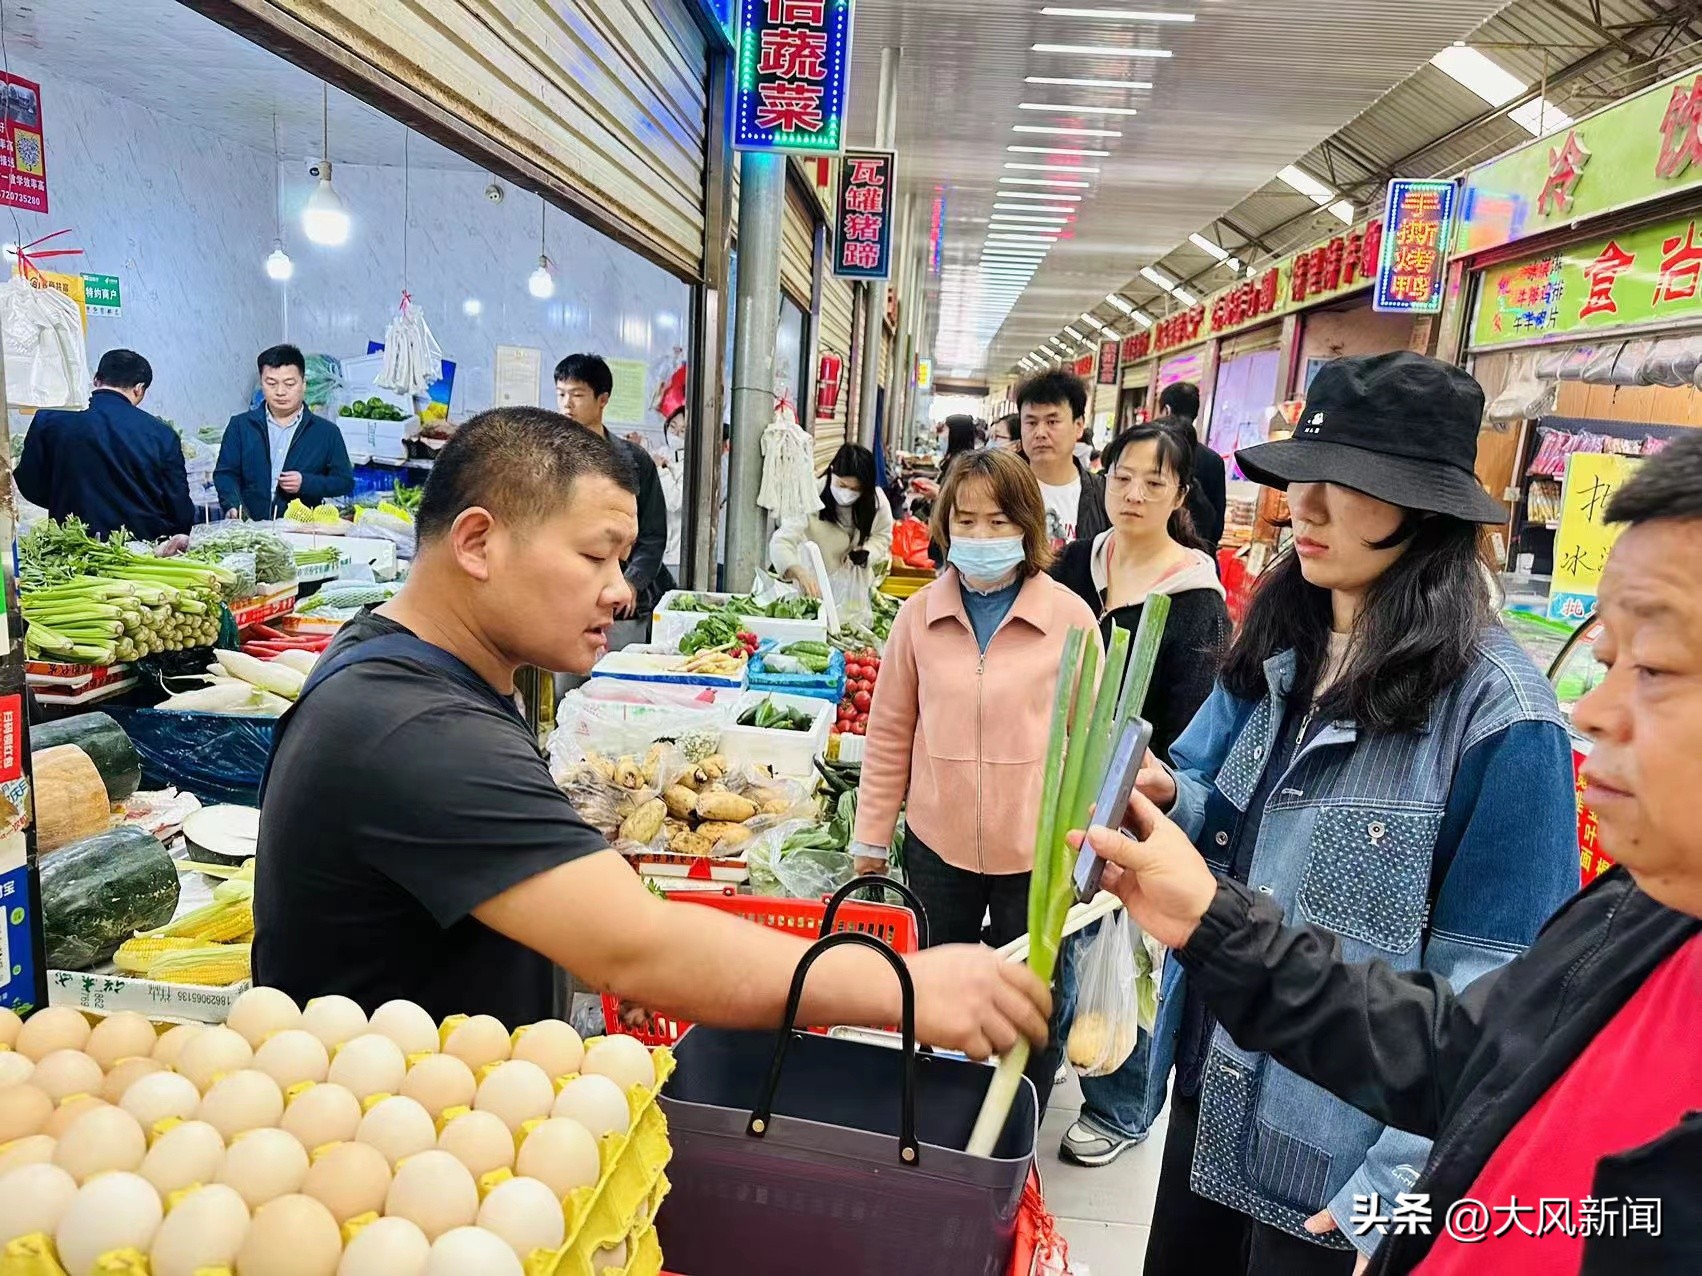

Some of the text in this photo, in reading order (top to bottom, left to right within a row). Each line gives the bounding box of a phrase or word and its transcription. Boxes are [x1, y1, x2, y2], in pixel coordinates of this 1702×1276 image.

[0, 189, 41, 206] 720735280
[842, 158, 884, 269] 瓦罐猪蹄
[1390, 191, 1441, 301] 手撕烤鸭
[85, 286, 117, 300] 特约商户
